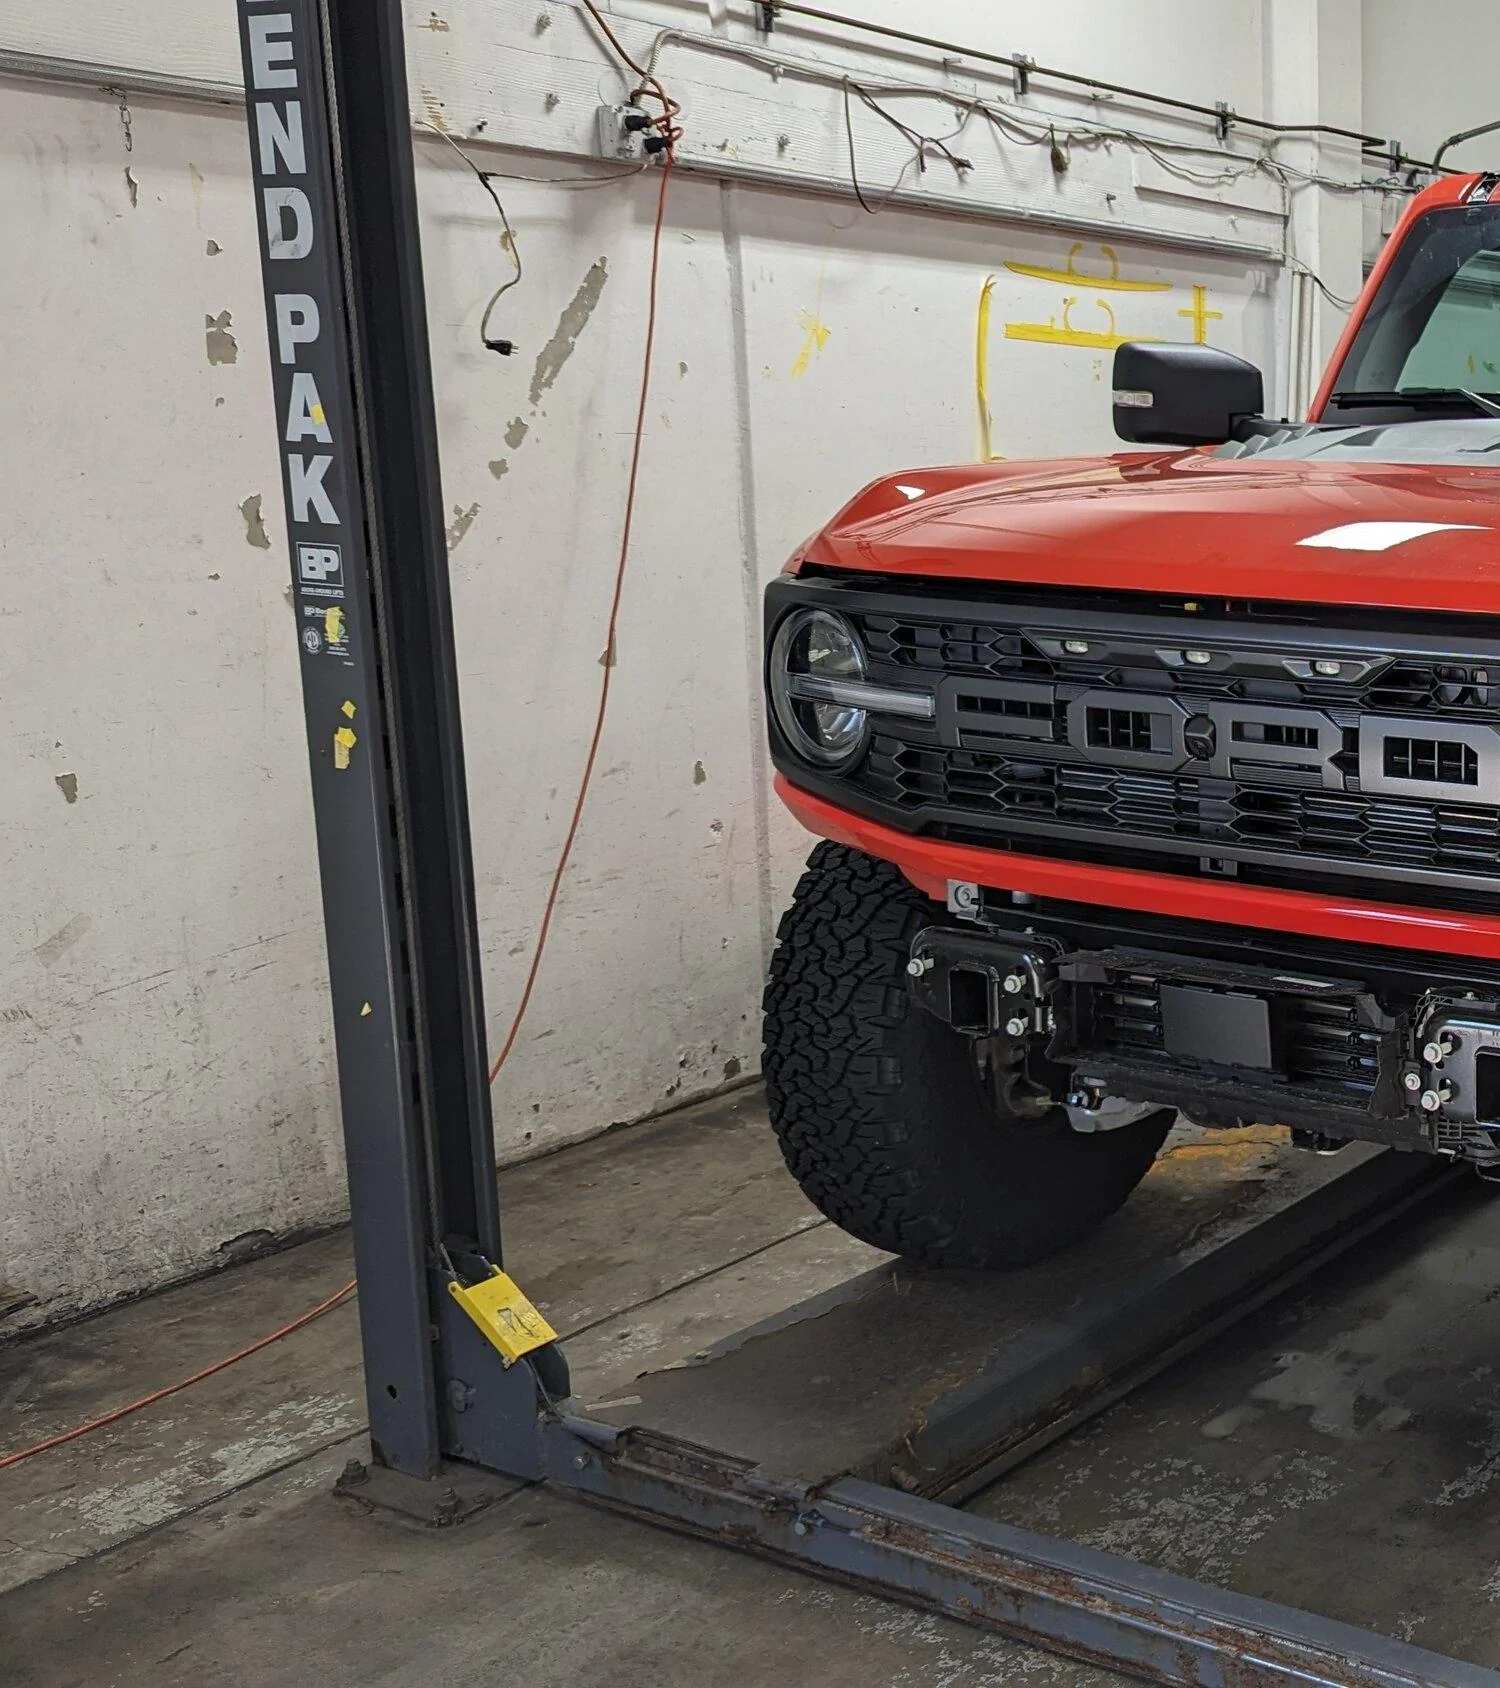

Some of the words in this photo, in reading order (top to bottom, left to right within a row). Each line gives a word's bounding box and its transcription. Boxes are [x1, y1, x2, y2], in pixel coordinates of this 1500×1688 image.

[246, 0, 315, 260] END
[274, 293, 341, 525] PAK
[299, 547, 340, 580] BP
